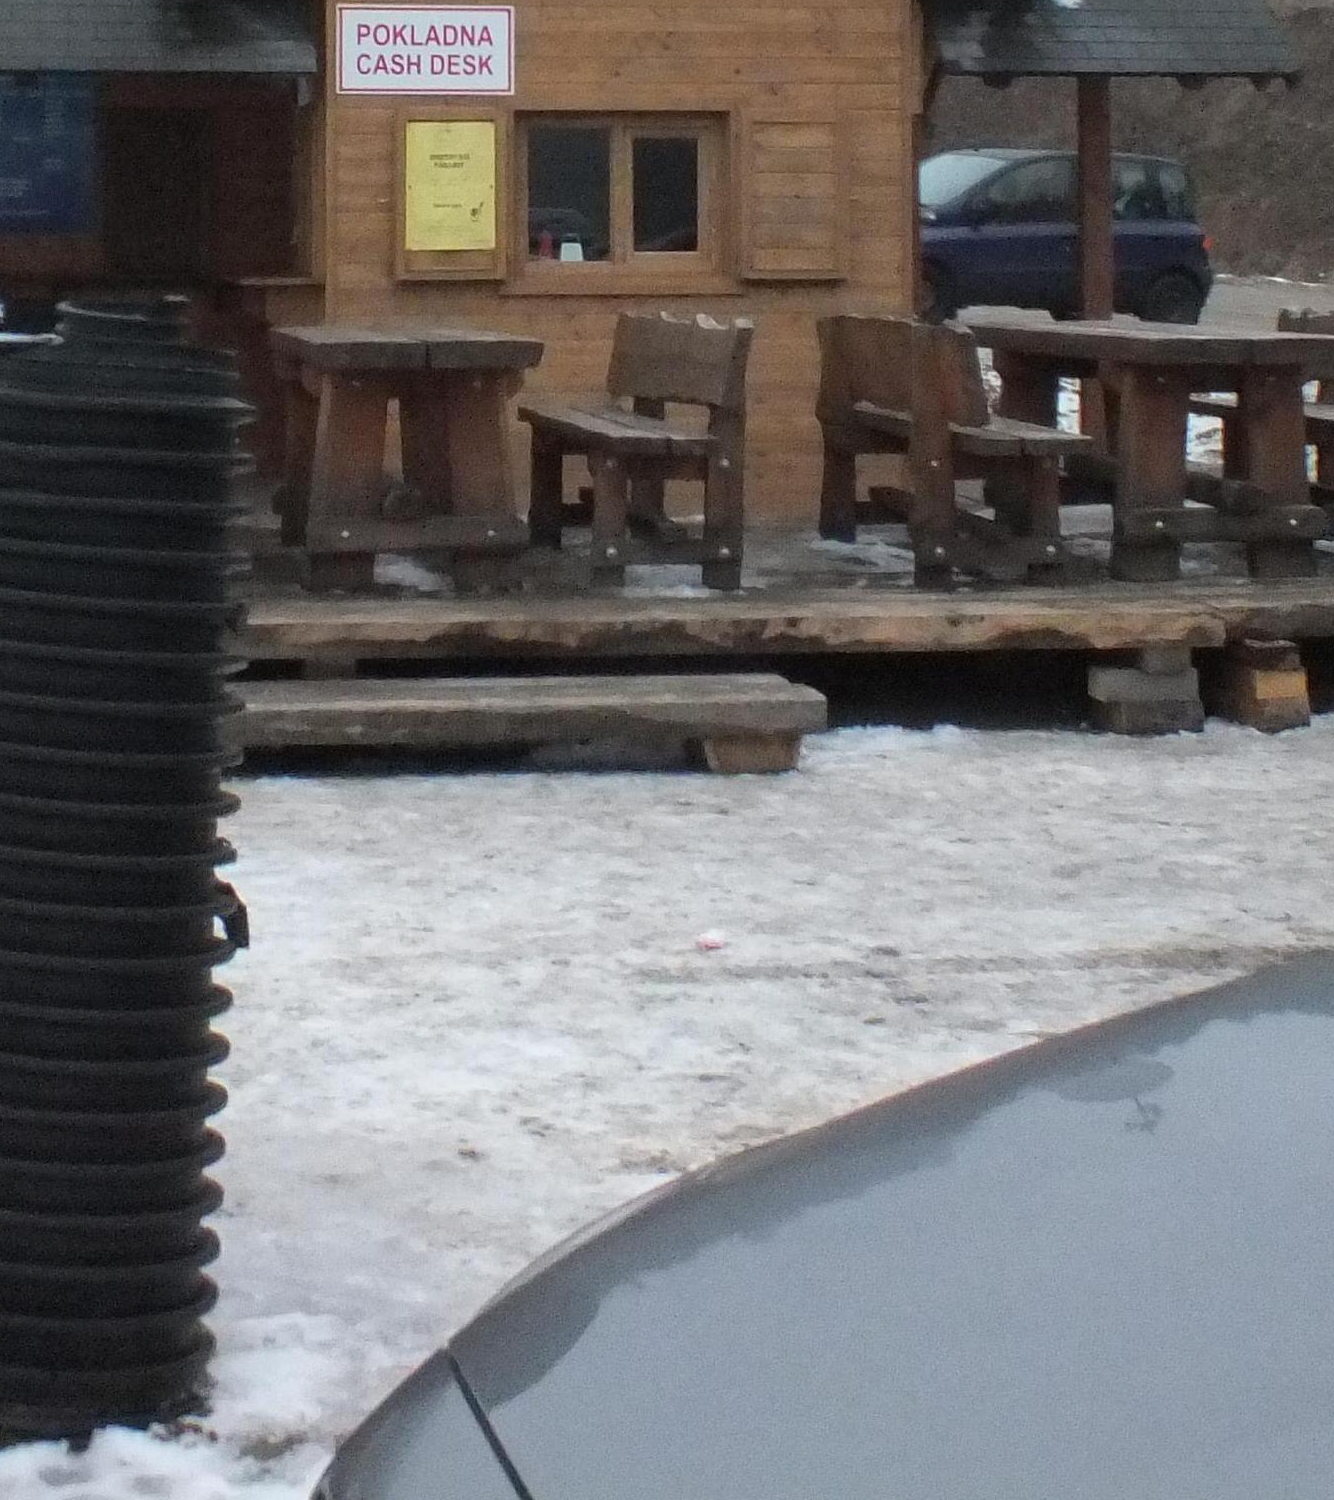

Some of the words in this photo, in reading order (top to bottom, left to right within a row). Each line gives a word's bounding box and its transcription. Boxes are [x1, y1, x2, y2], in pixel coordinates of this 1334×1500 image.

[357, 24, 493, 46] POKLADNA
[357, 54, 421, 75] CASH
[431, 54, 493, 75] DESK
